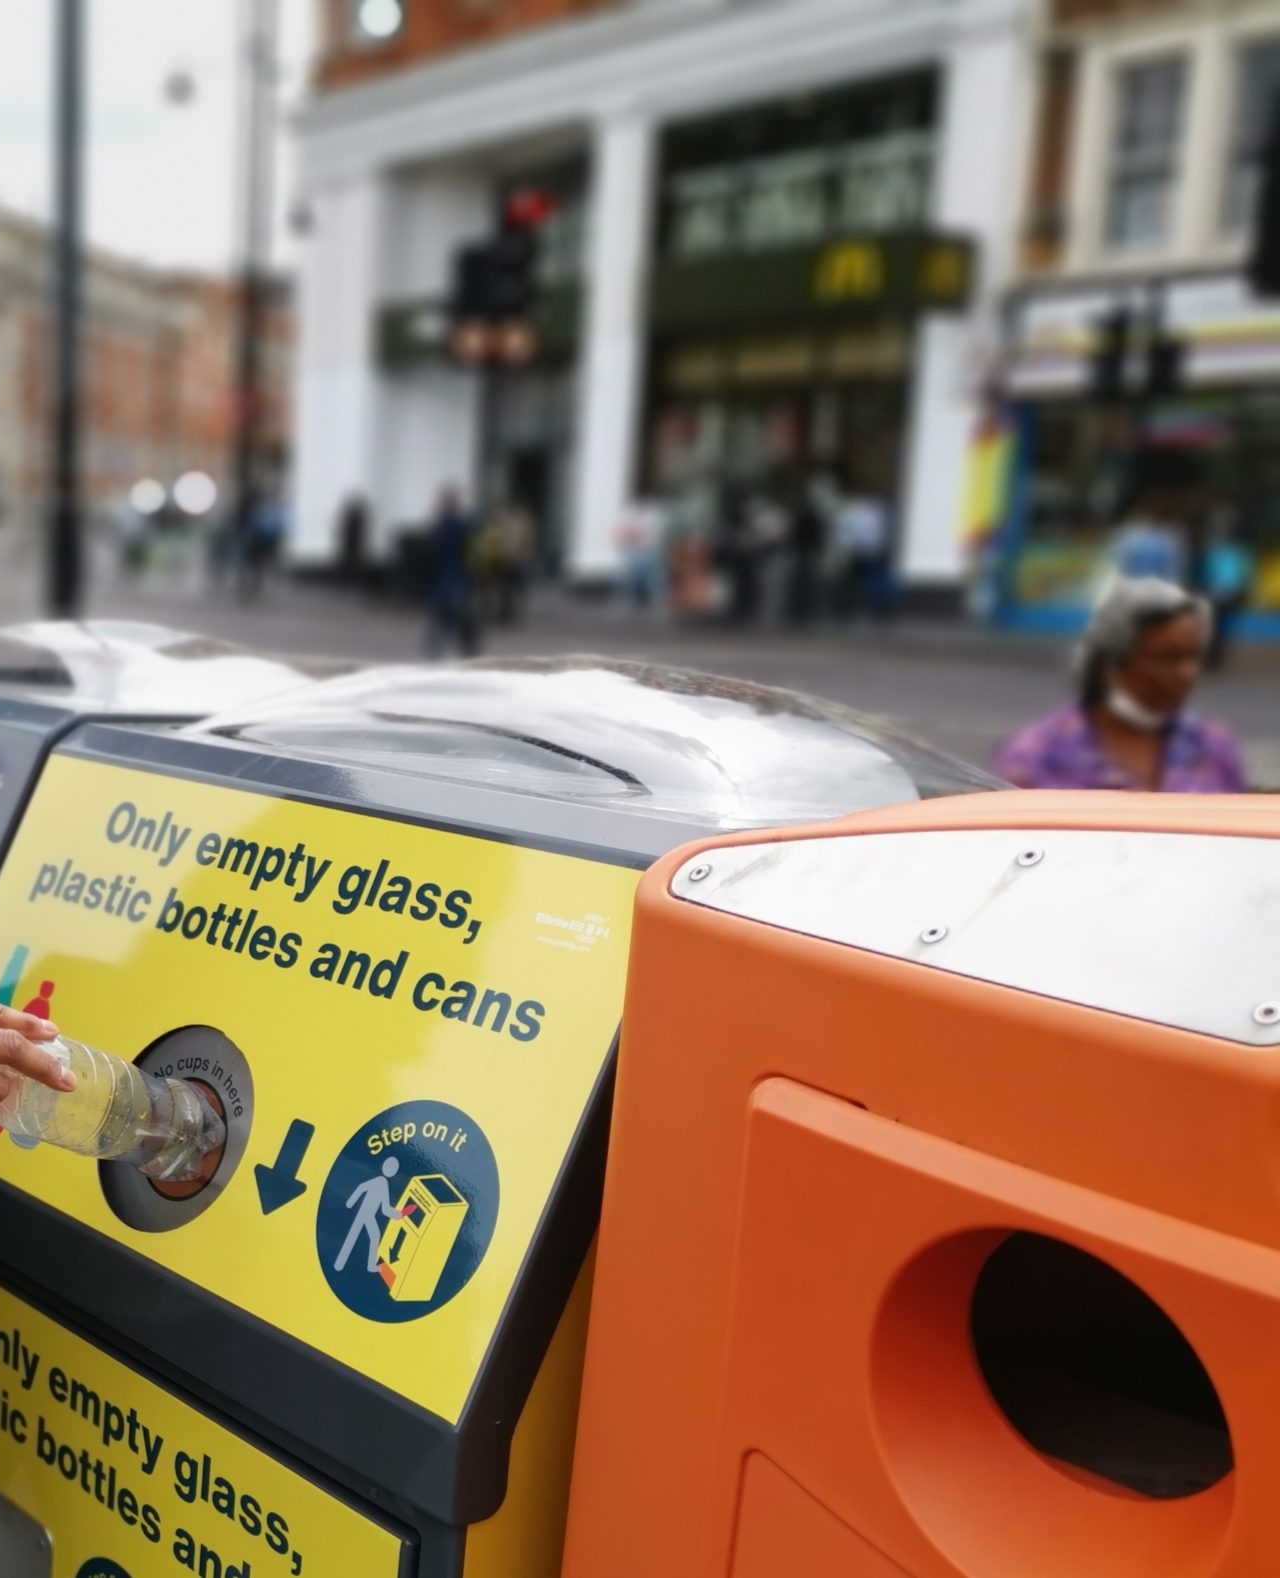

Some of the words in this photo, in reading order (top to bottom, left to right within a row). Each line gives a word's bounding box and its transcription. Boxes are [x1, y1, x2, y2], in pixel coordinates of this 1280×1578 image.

[106, 801, 192, 867] Only
[195, 832, 333, 903] empty
[332, 859, 482, 944] glass,
[29, 858, 151, 923] plastic
[155, 887, 303, 969] bottles
[309, 942, 410, 1000] and
[412, 972, 546, 1042] cans
[177, 1057, 210, 1073] cups
[211, 1060, 224, 1081] in
[223, 1074, 244, 1118] here
[367, 1121, 417, 1155] Step
[422, 1121, 448, 1142] on
[449, 1128, 467, 1152] it
[36, 1416, 162, 1543] bottles
[49, 1367, 164, 1475] empty
[174, 1451, 303, 1577] glass,
